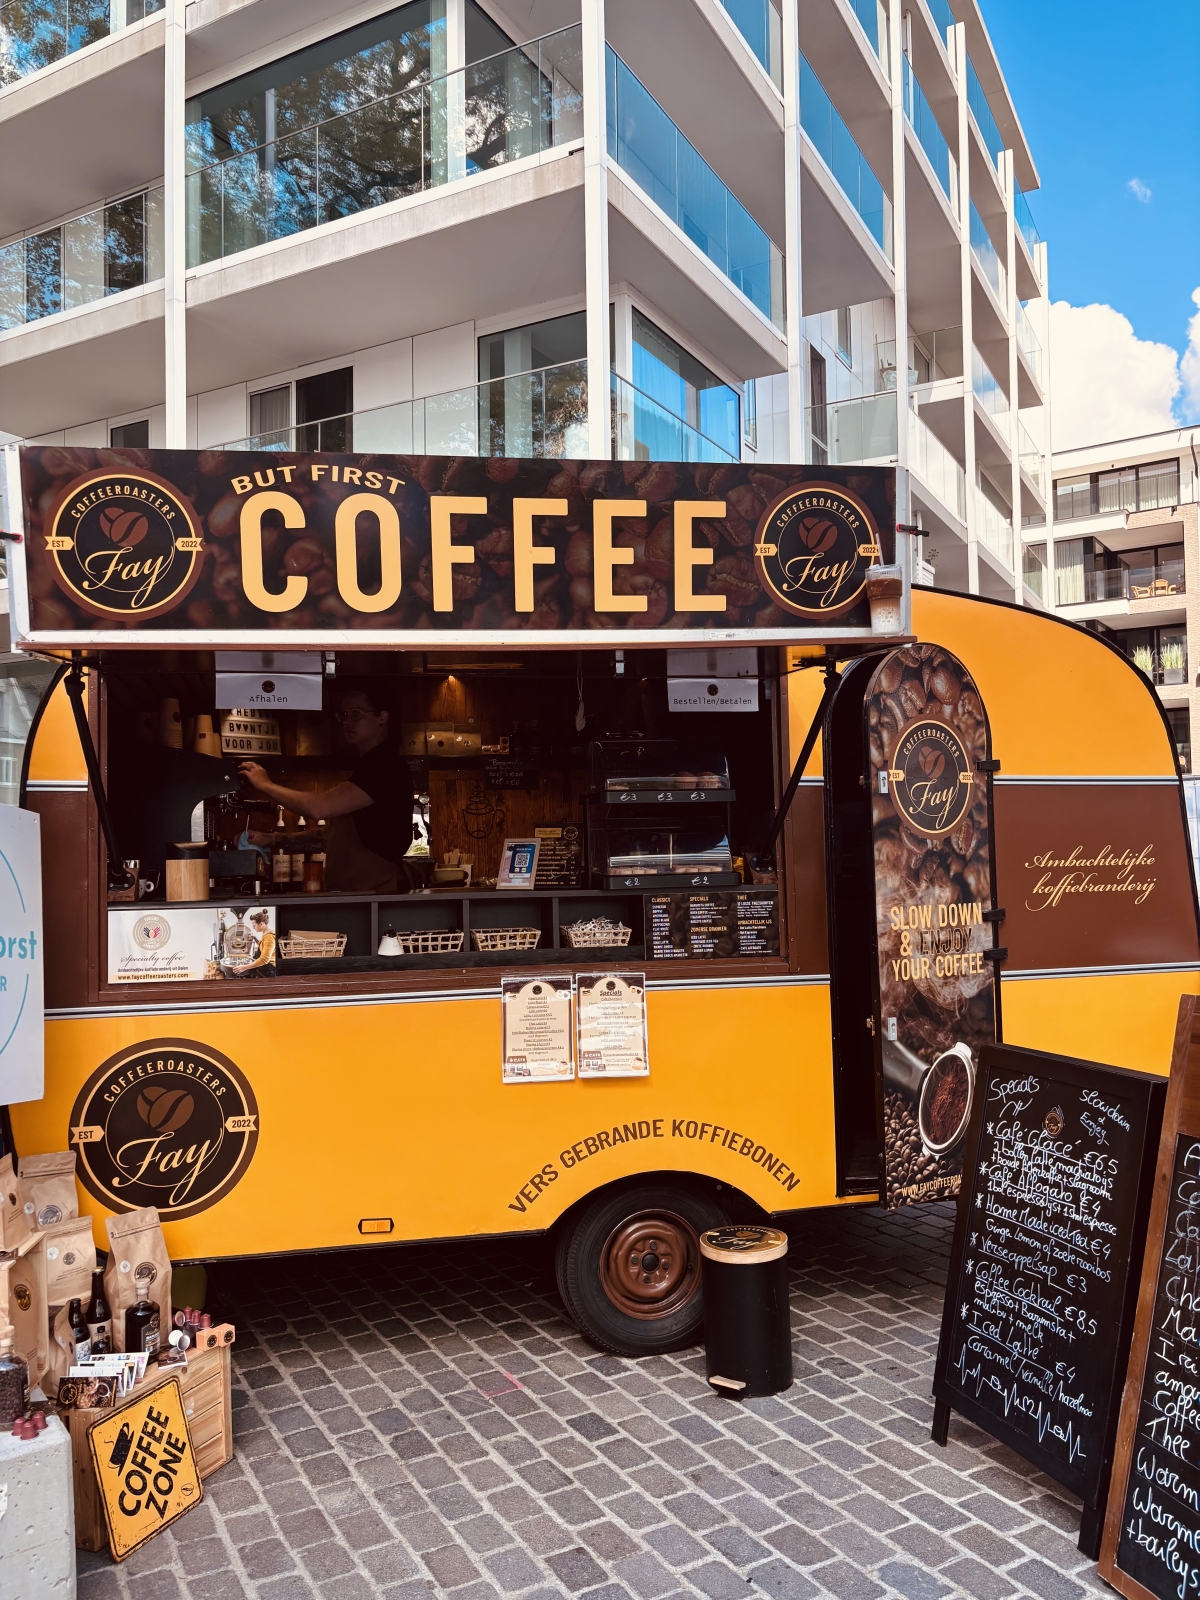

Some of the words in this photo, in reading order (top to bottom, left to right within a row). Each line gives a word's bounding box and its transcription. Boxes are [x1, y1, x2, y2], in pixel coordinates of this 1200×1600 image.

[230, 466, 297, 495] BUT
[311, 464, 406, 495] FIRST
[71, 485, 176, 518] COFFEEROASTERS
[776, 497, 860, 529] COFFEEROASTERS
[52, 539, 65, 548] EST
[181, 539, 199, 548] 2022
[240, 491, 728, 613] COFFEE
[760, 547, 771, 555] EST
[863, 546, 876, 555] 2022
[82, 546, 174, 608] Fay
[782, 551, 857, 607] Fay
[249, 694, 288, 703] Afhalen
[673, 697, 752, 706] Bestellen/Betalen
[225, 738, 252, 749] VOOR
[259, 741, 278, 750] JOU
[903, 728, 960, 758] COFFEEROASTERS
[620, 792, 637, 801] €3
[657, 792, 673, 801] €3
[690, 791, 706, 800] €3
[908, 778, 959, 829] Fay
[1024, 844, 1155, 879] Ambachtelijke
[625, 878, 640, 886] €2
[691, 876, 709, 885] €2
[1025, 872, 1157, 911] koffiebranderij
[890, 905, 932, 930] SLOW
[938, 903, 983, 927] DOWN
[900, 931, 912, 956] &
[919, 928, 972, 955] ENJOY
[120, 952, 159, 967] Specialty
[161, 950, 186, 966] coffee
[892, 959, 930, 981] YOUR
[935, 953, 985, 977] COFFEE
[118, 973, 189, 981] www.faycoffeeroasters.com
[104, 1060, 227, 1103] COFFEEROASTERS
[988, 1075, 1040, 1103] Specials
[78, 1131, 94, 1139] EST
[231, 1119, 251, 1128] 2022
[1080, 1111, 1108, 1145] Enjoy
[112, 1128, 223, 1206] Fay
[508, 1164, 559, 1213] VERS
[559, 1119, 664, 1169] GEBRANDE
[671, 1119, 801, 1193] KOFFIEBONEN
[985, 1193, 1018, 1221] Home
[1019, 1206, 1049, 1233] Made
[975, 1261, 1010, 1291] Coffee
[1013, 1277, 1062, 1316] Cocktail
[1145, 1416, 1190, 1463] Thee
[118, 1406, 170, 1517] COFFEE
[145, 1432, 186, 1520] ZONE
